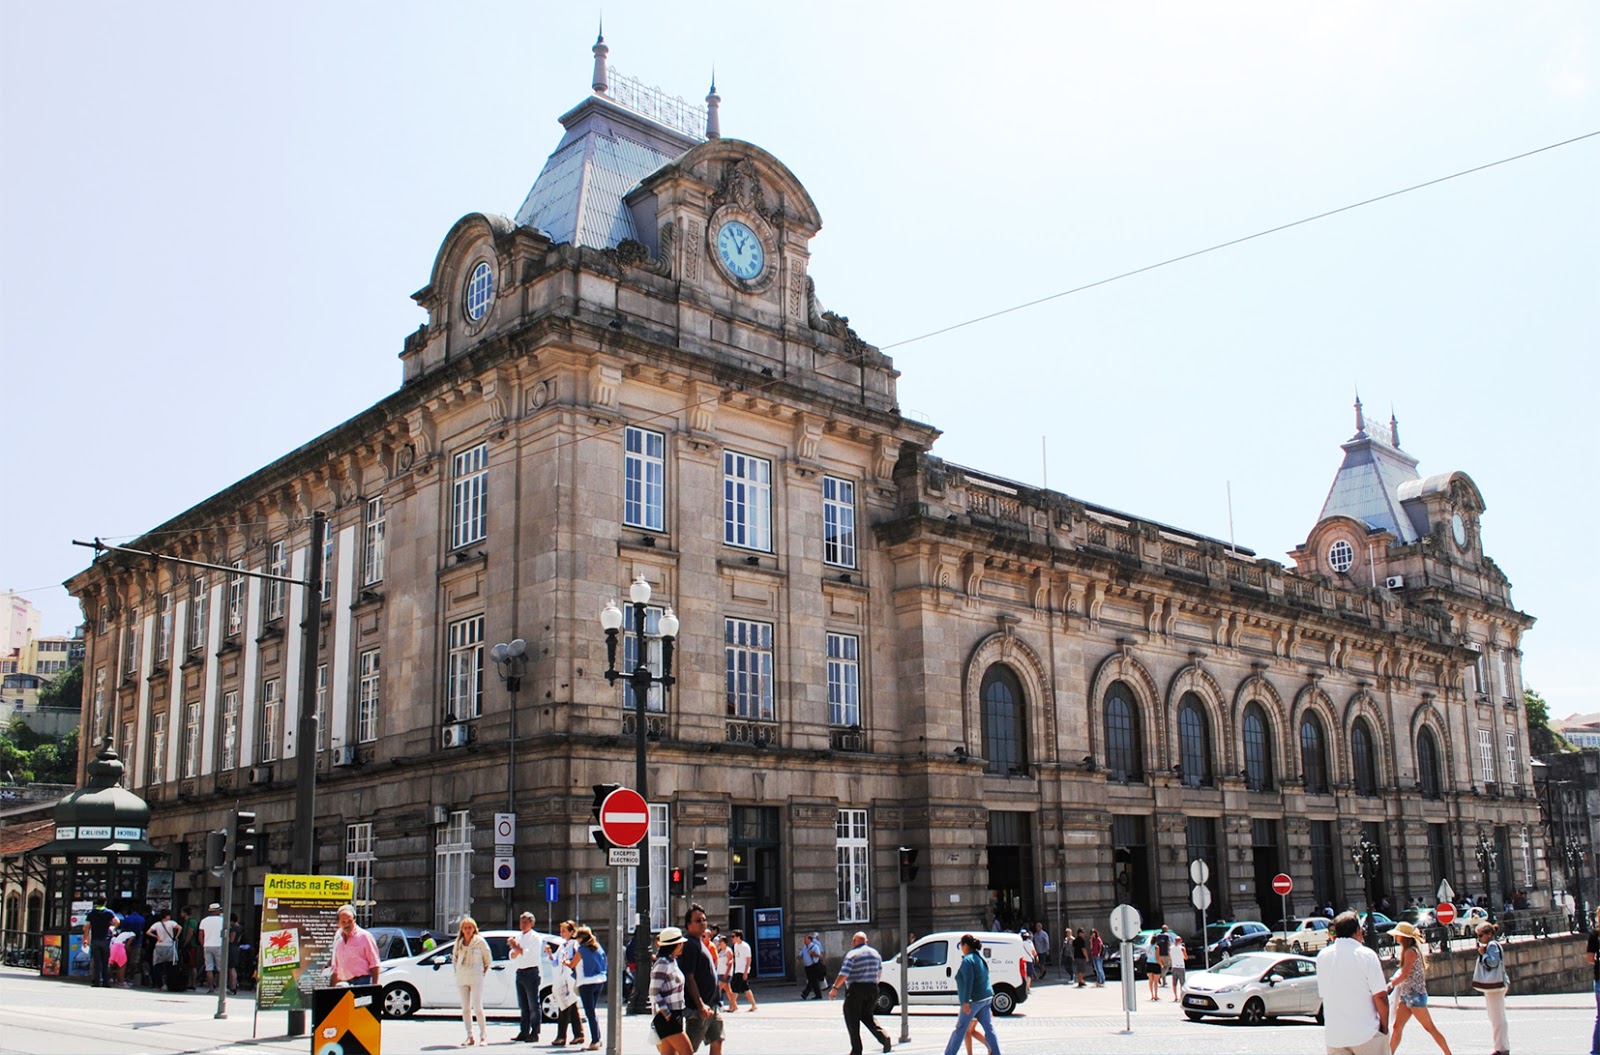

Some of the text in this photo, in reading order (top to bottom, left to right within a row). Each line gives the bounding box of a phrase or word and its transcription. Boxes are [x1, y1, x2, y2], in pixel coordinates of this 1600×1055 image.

[269, 878, 306, 889] Artistas
[324, 880, 349, 890] Festa
[265, 946, 297, 959] Festa
